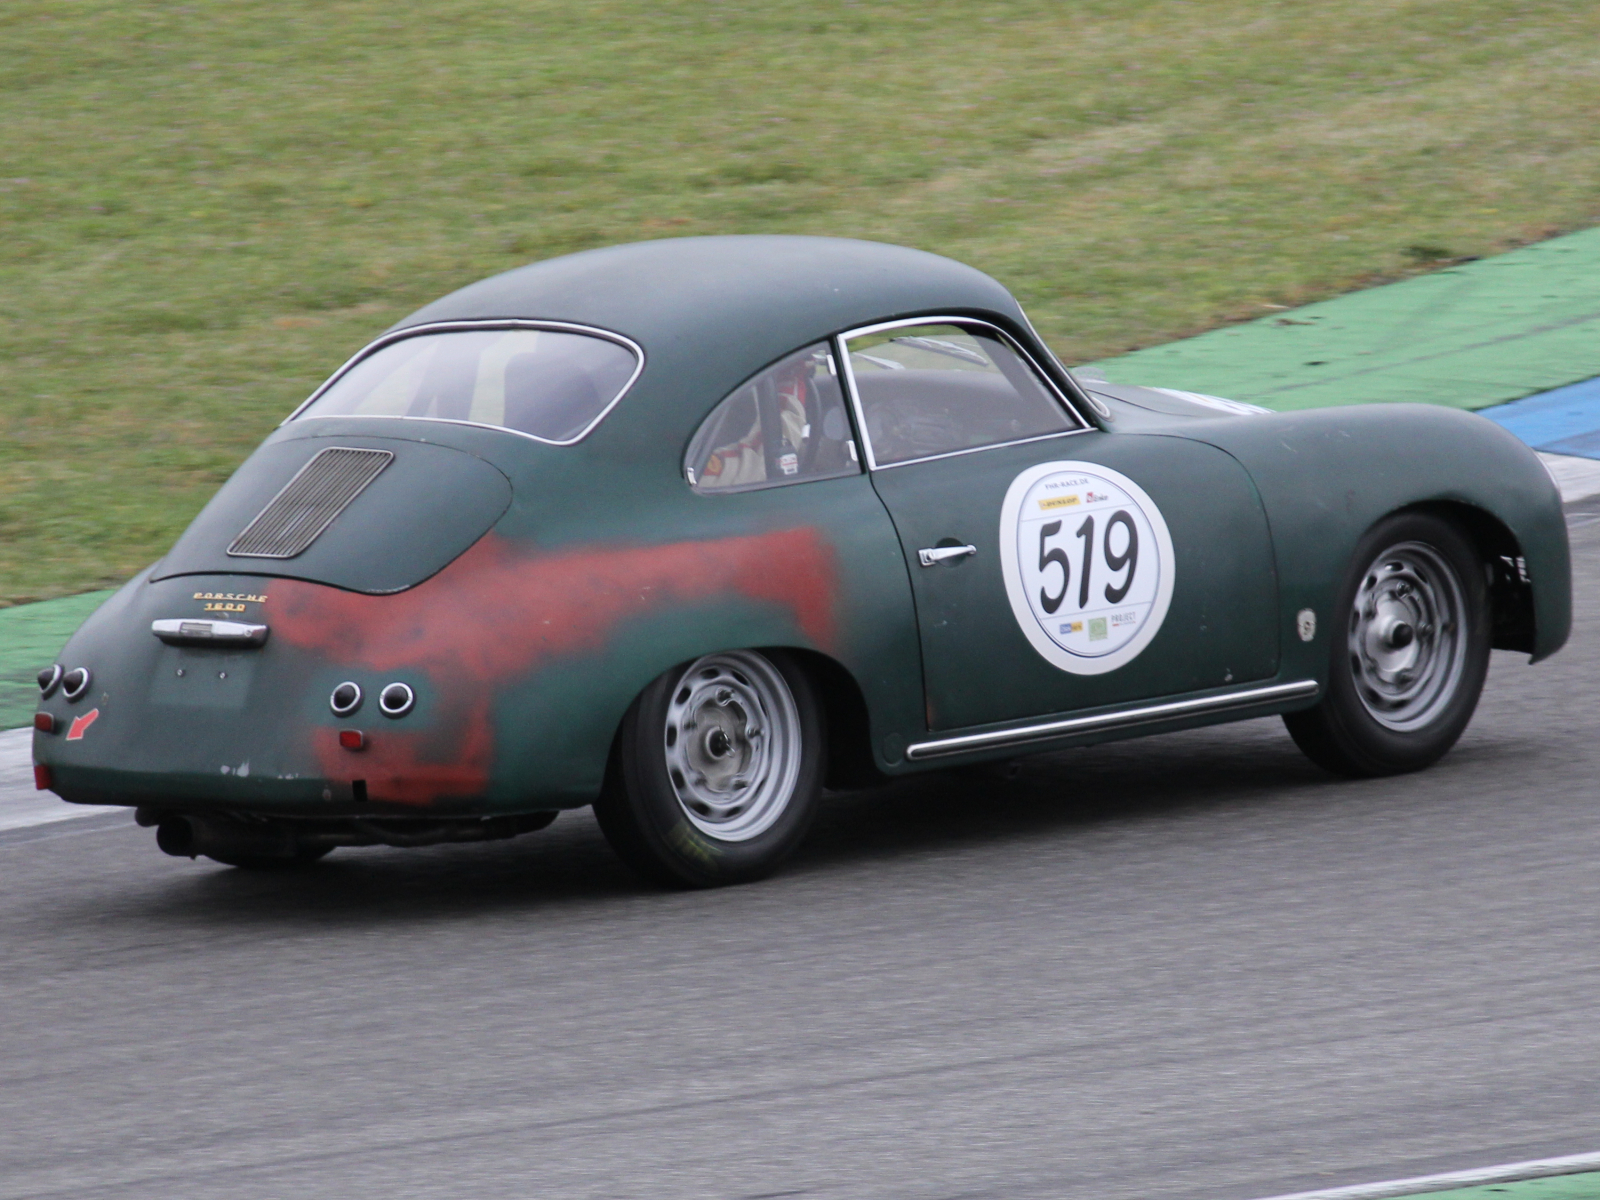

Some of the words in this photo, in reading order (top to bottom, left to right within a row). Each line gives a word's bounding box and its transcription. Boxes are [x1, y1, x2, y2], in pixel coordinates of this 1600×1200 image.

[1046, 497, 1078, 507] DUNLOP
[1038, 509, 1139, 615] 519
[193, 592, 268, 603] PORSCHE
[203, 602, 246, 612] 1600
[1111, 611, 1136, 623] PROJECT
